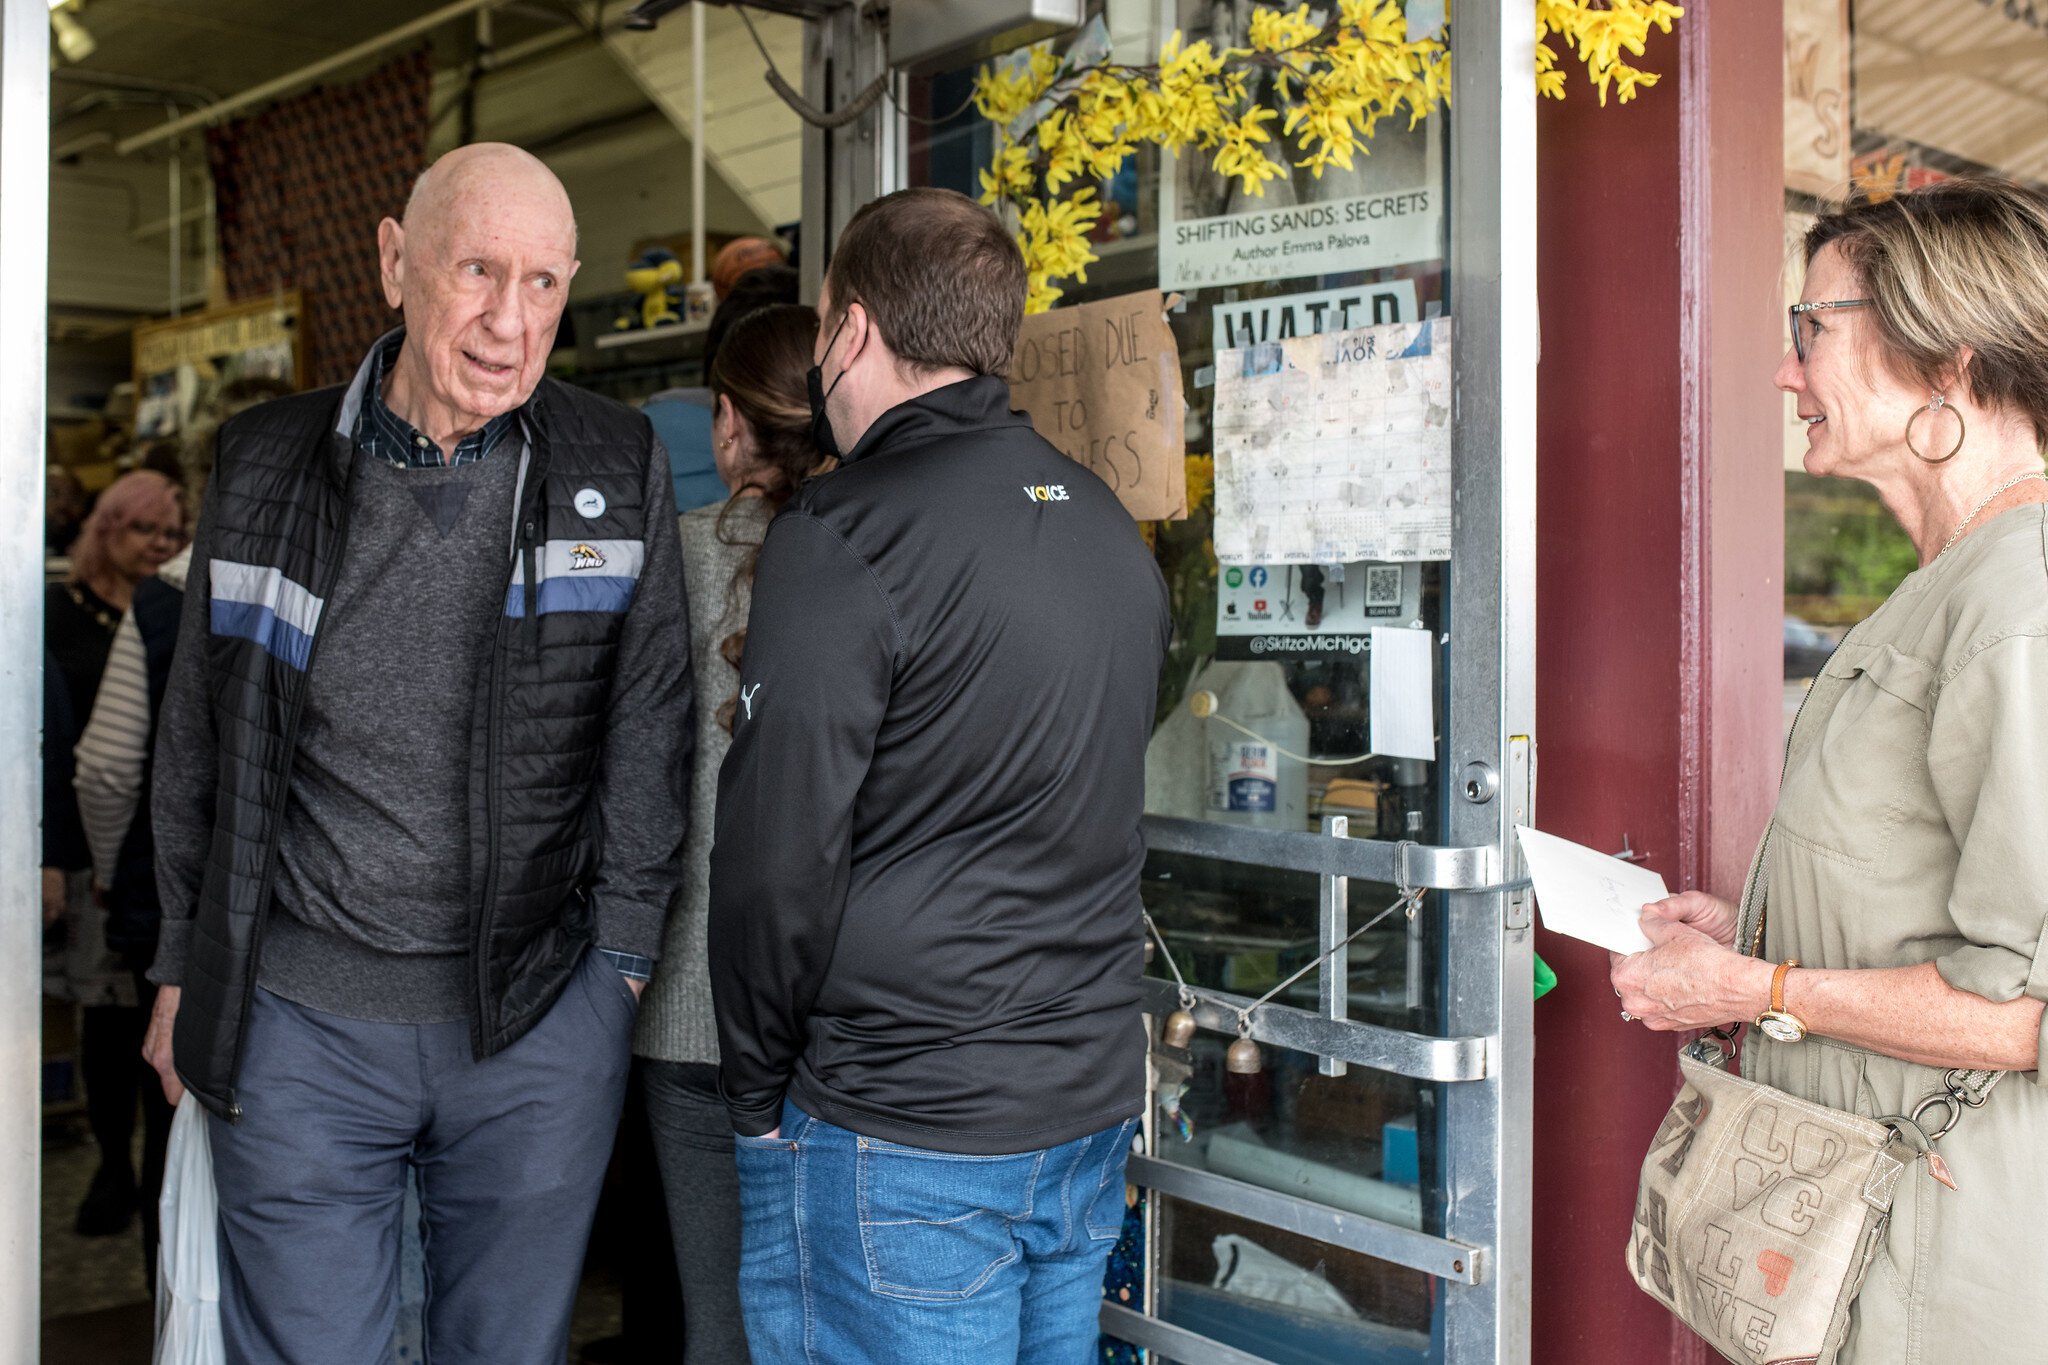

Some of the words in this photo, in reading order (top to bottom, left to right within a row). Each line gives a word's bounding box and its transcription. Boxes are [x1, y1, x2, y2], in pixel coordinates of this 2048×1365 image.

[1176, 215, 1265, 245] SHIFTING
[1270, 207, 1340, 232] SANDS:
[1345, 191, 1429, 221] SECRETS
[1233, 245, 1277, 262] Author
[1282, 239, 1323, 256] Emma
[1328, 232, 1370, 250] Palova
[1105, 311, 1147, 370] DUE
[1054, 399, 1087, 434] TO
[1023, 485, 1070, 502] VOICE
